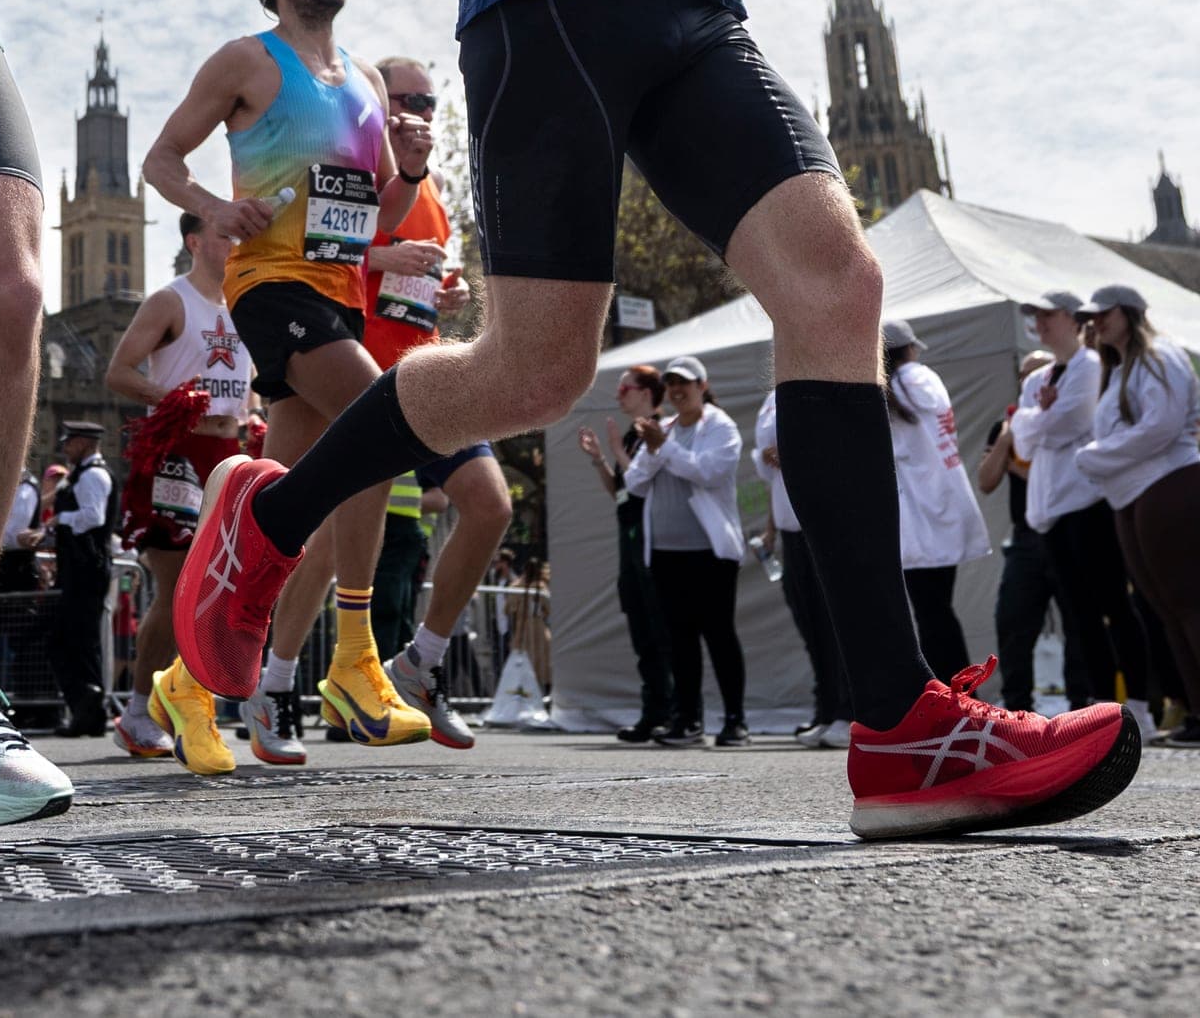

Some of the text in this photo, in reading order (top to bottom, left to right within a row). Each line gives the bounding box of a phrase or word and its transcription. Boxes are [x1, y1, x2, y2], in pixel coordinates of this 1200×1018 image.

[315, 172, 344, 194] tcs
[321, 206, 368, 234] 42817
[206, 336, 239, 351] CHEER
